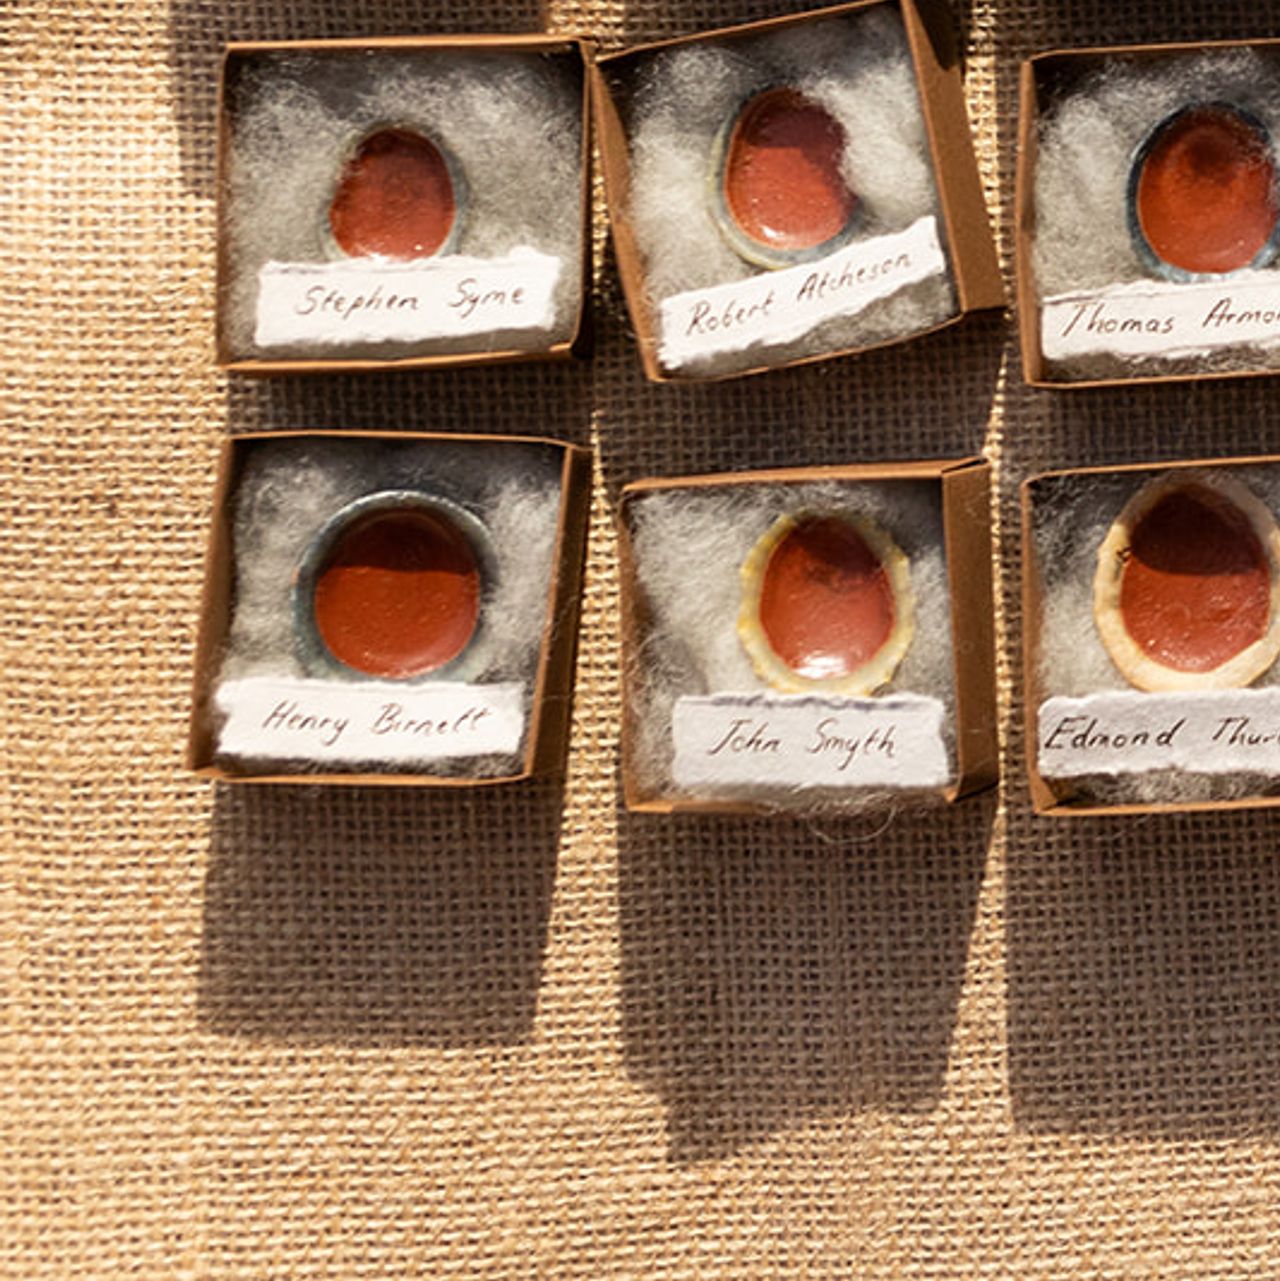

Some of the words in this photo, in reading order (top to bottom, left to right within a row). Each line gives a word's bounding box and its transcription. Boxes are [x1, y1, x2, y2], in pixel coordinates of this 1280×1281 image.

[298, 283, 418, 317] Stephen
[688, 295, 773, 336] Robert
[1063, 301, 1173, 335] Thomas
[262, 701, 349, 746] Henry
[1045, 716, 1184, 749] Edmond
[709, 720, 779, 755] John
[804, 721, 895, 769] Smyth
